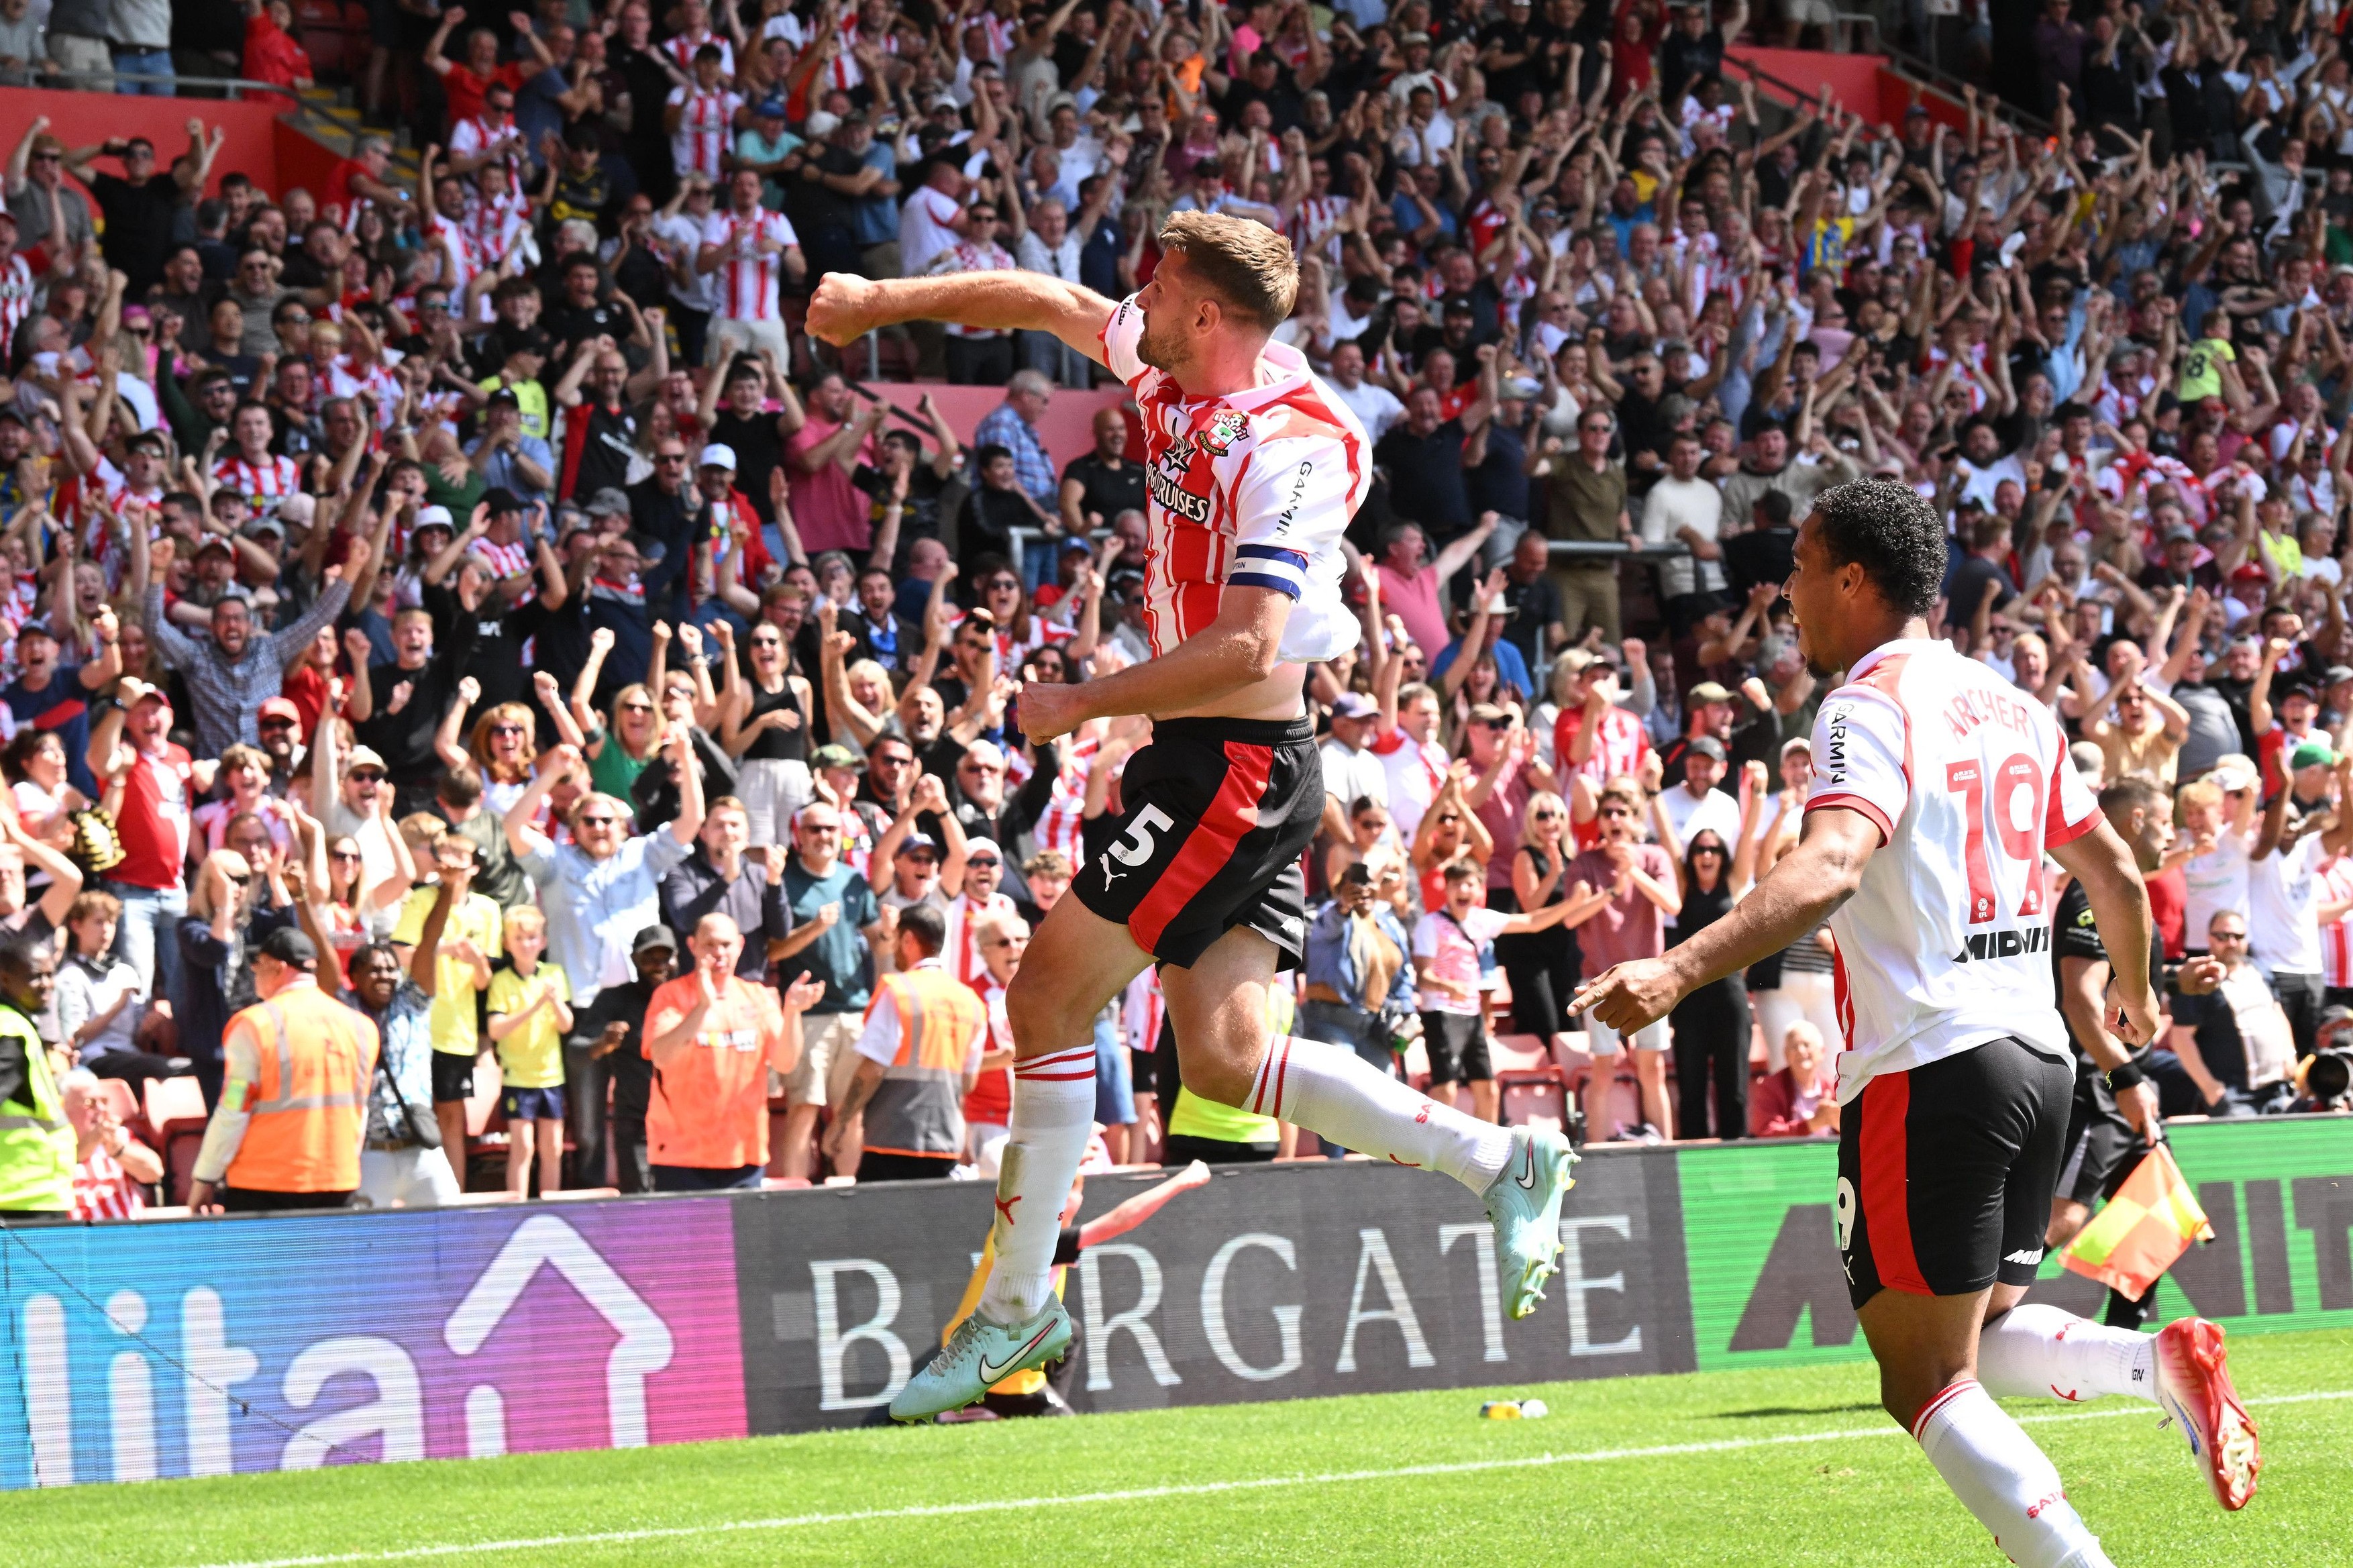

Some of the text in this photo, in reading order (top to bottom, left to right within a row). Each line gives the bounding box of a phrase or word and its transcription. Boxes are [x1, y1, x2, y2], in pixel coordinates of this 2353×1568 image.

[1198, 431, 1219, 454] SOUTHAMPTON
[1829, 702, 1854, 785] GARMIN
[1943, 688, 2030, 745] ARCHER
[1108, 802, 1175, 866] 5
[1945, 752, 2044, 924] 19
[1837, 1176, 1856, 1251] 9
[808, 1214, 1642, 1410] BRGATE
